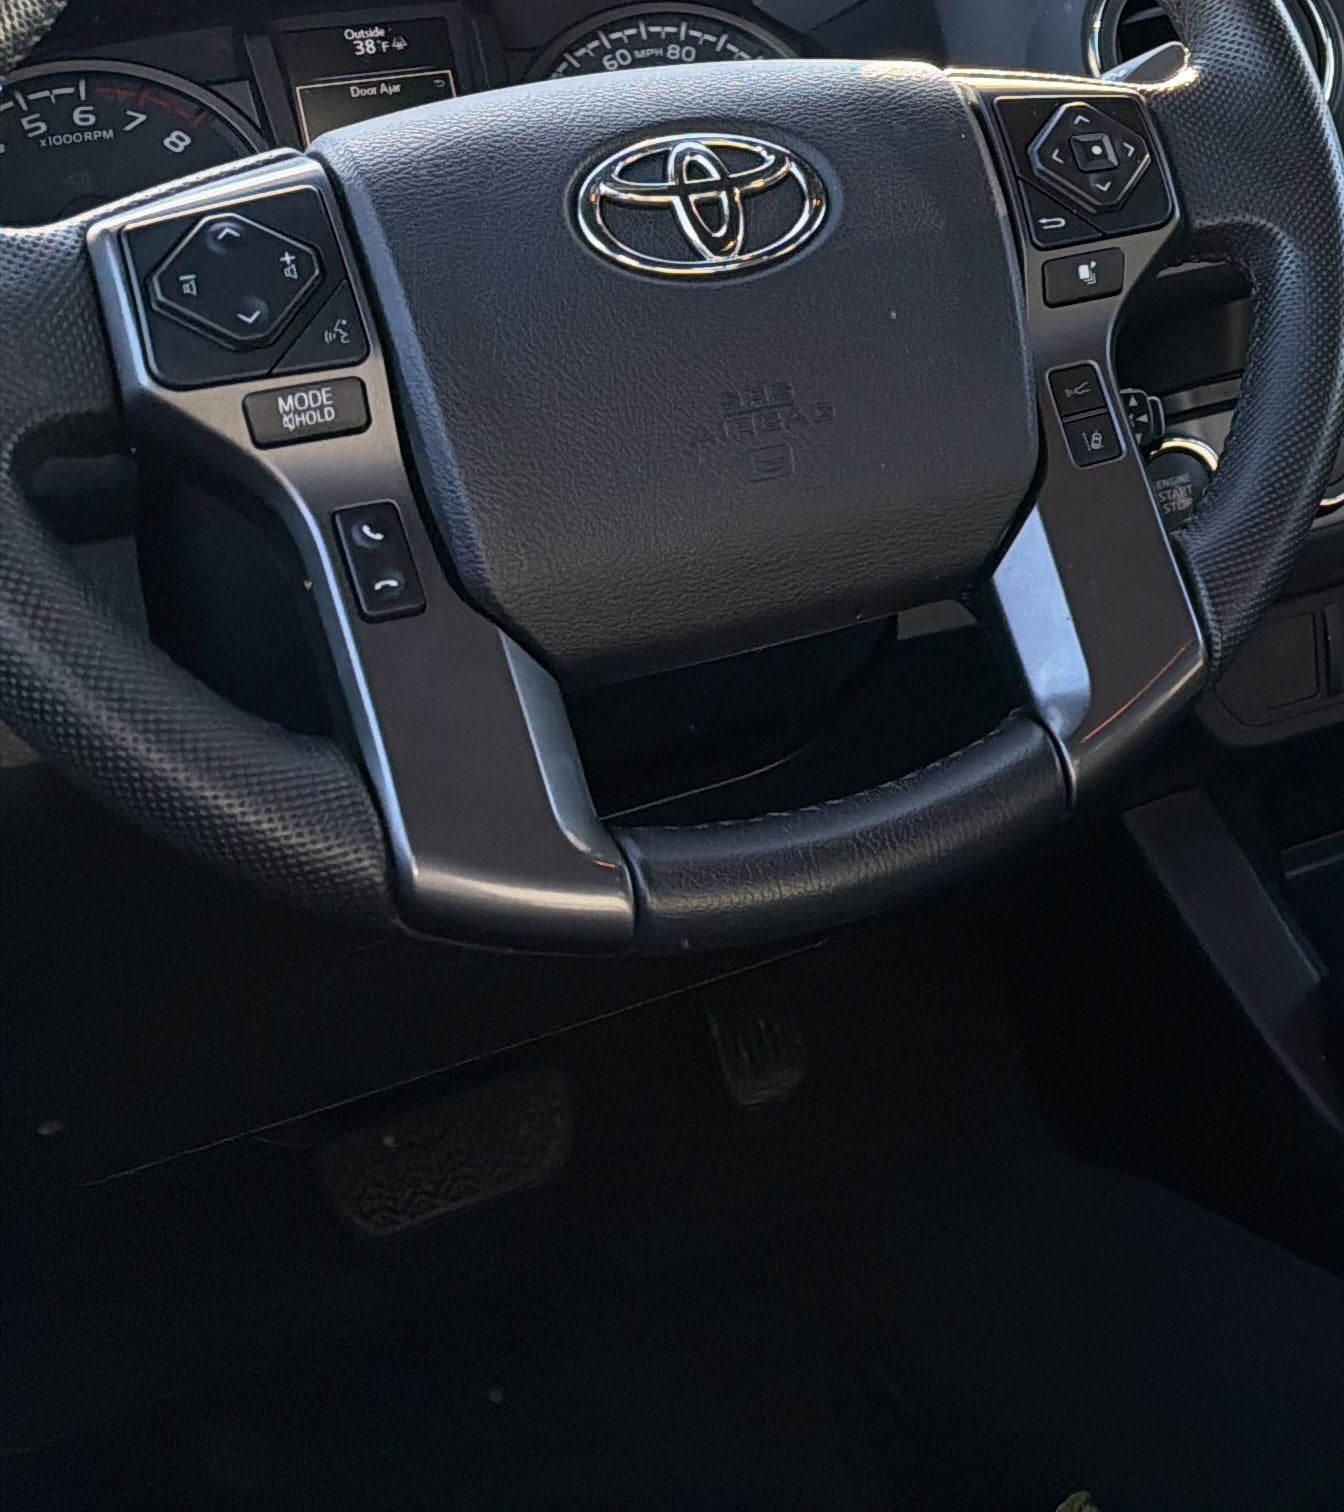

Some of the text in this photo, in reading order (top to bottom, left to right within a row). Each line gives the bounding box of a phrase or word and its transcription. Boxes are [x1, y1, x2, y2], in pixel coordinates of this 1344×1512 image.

[344, 26, 385, 41] Outside
[602, 44, 696, 72] 60 MPH 80
[350, 82, 402, 99] Door Ajar
[20, 105, 193, 153] 5 6 7 8
[277, 388, 334, 414] MODE
[294, 406, 336, 427] HOLD
[1158, 484, 1194, 504] START
[1163, 497, 1194, 515] STOP
